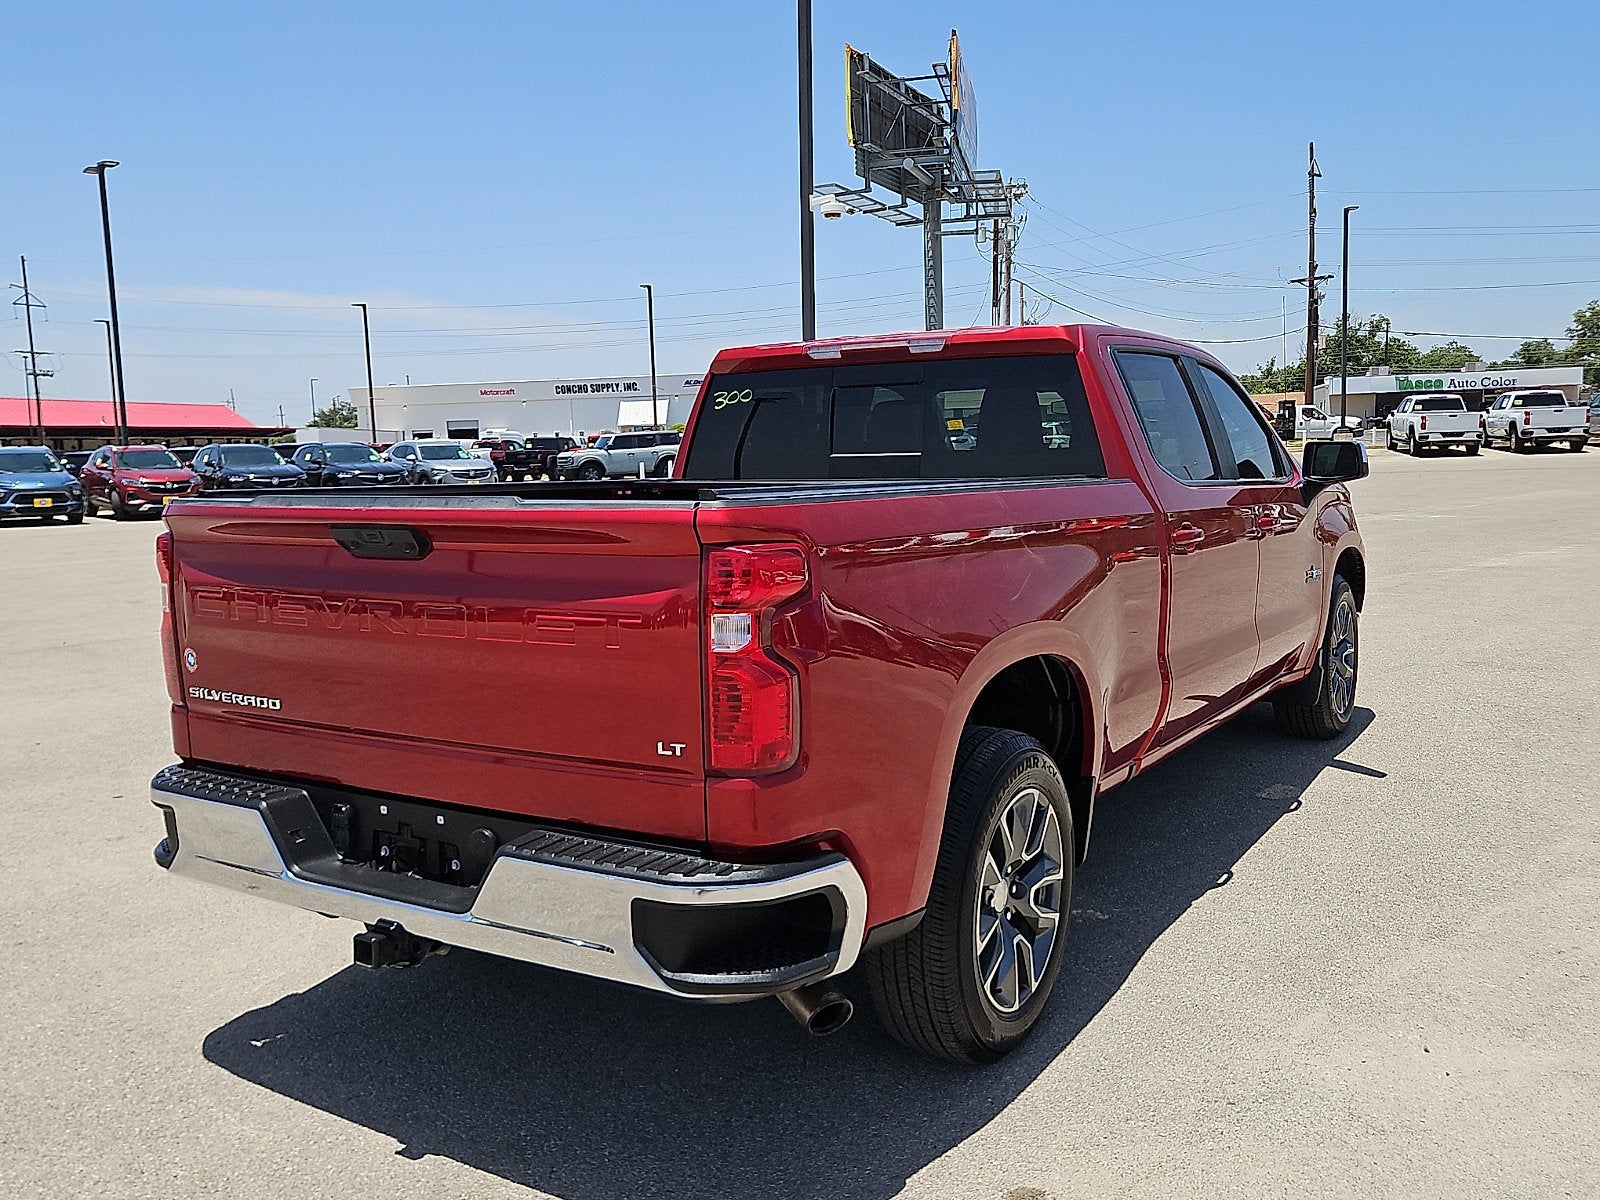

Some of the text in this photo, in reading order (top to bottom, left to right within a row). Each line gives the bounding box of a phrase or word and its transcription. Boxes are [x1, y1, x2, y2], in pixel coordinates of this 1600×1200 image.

[555, 383, 589, 395] CONCHO
[623, 381, 641, 392] INC.
[1447, 378, 1477, 389] Auto
[1480, 376, 1518, 388] Color
[480, 388, 515, 396] Motorcraft
[713, 388, 753, 410] 300
[190, 586, 643, 648] CHEVROLET
[189, 686, 281, 710] SILVERADO
[656, 741, 687, 756] LT
